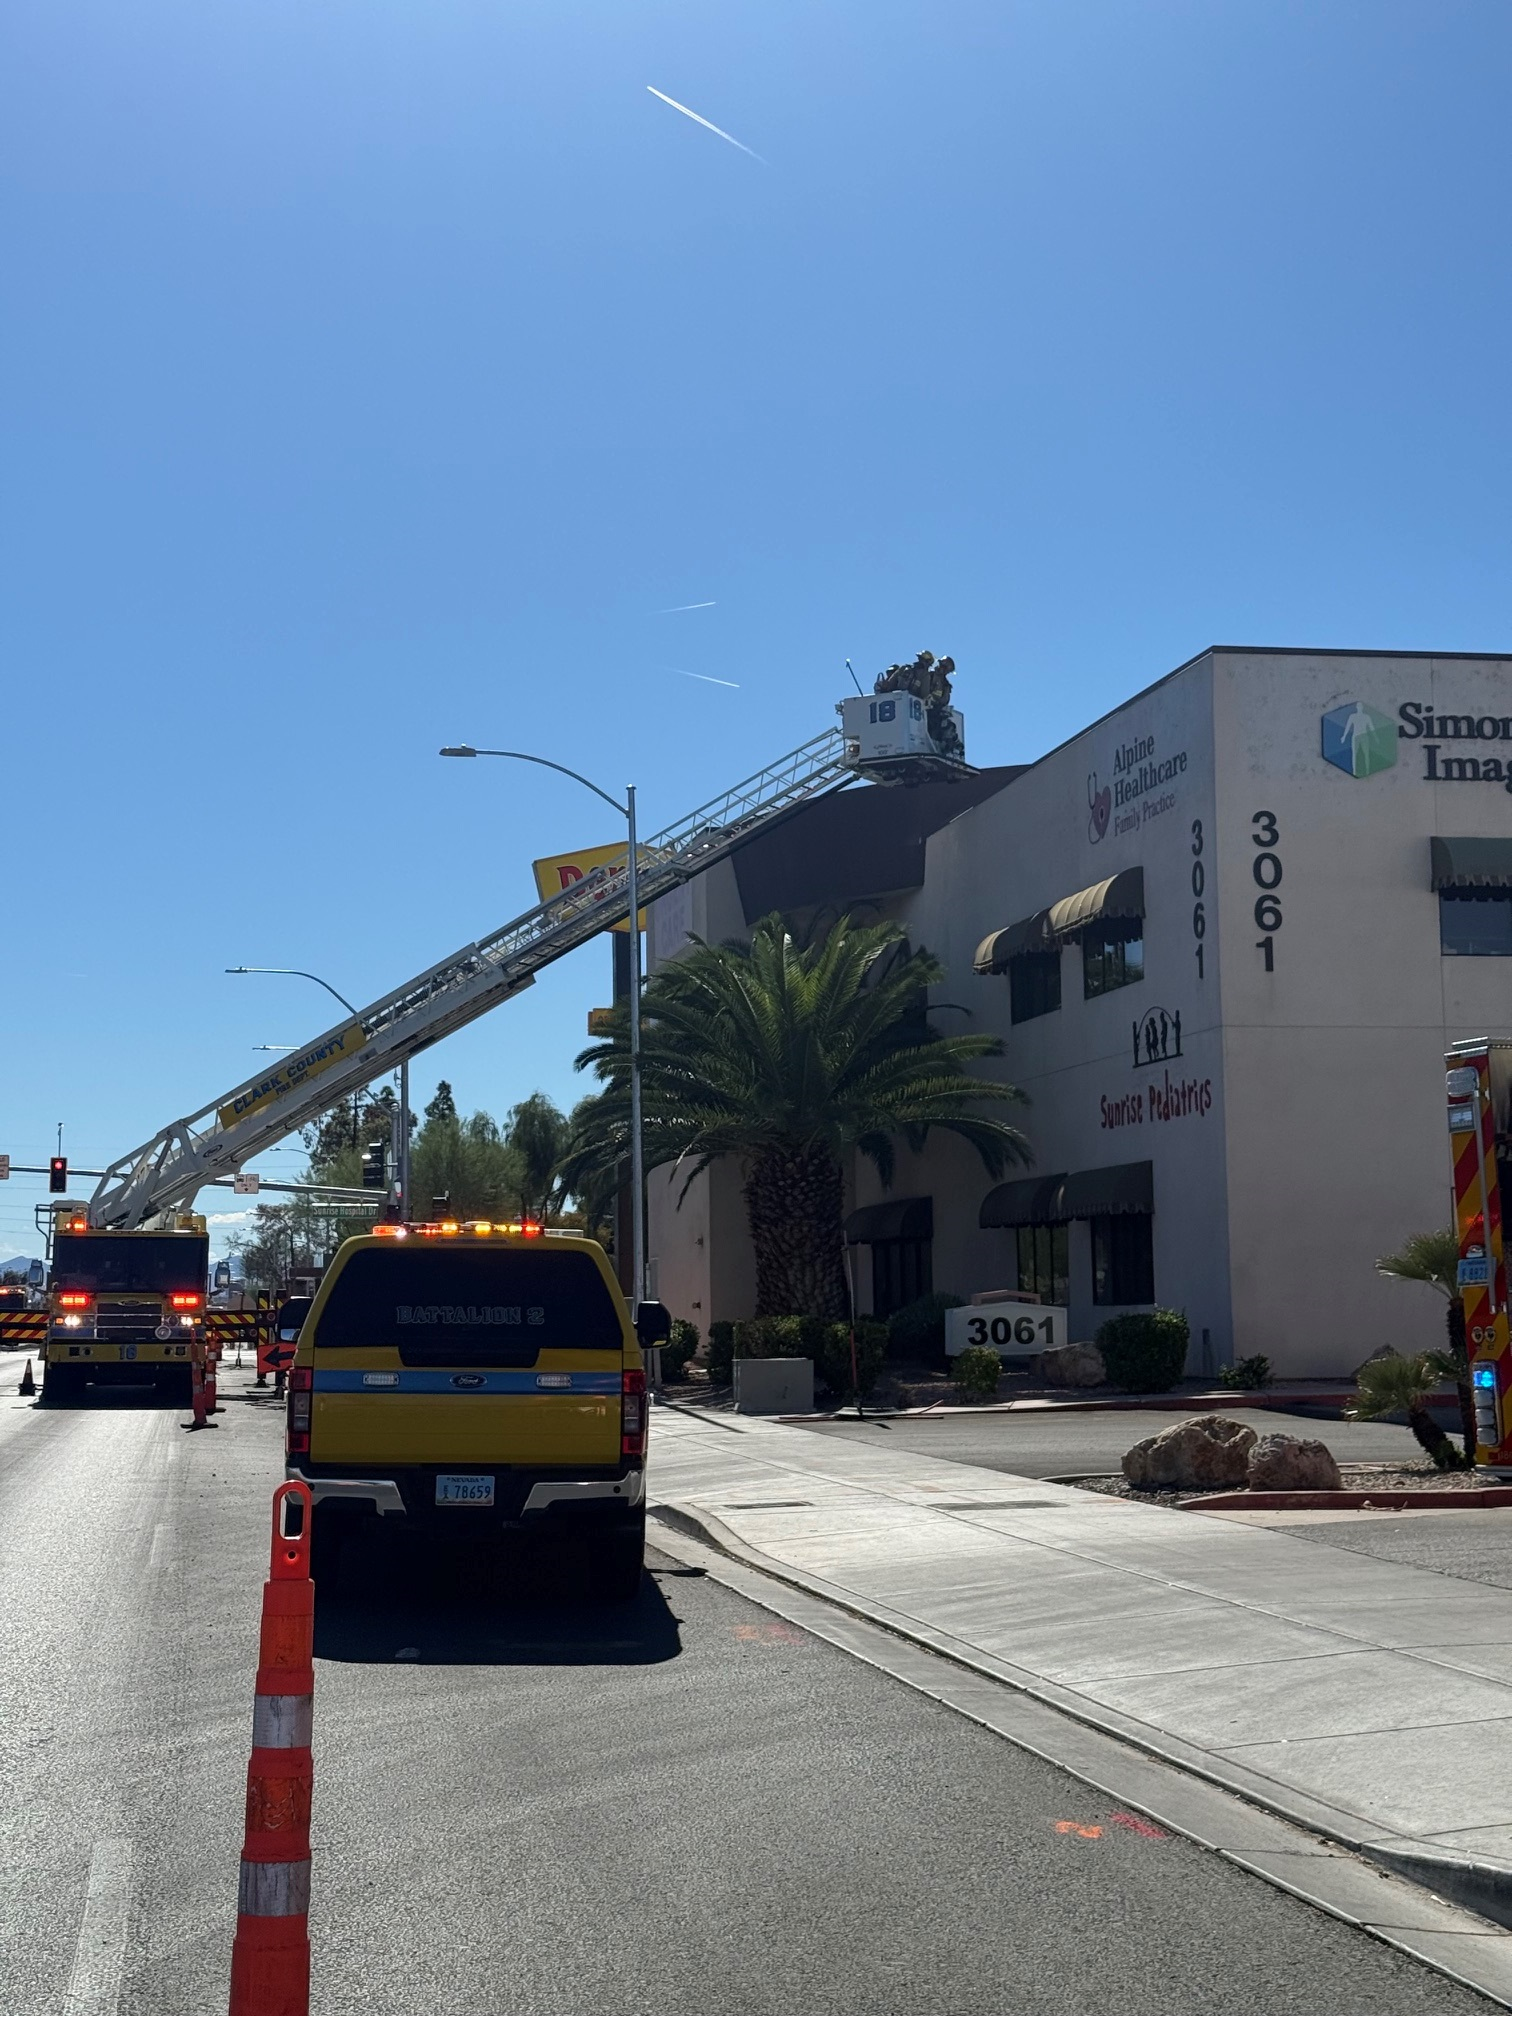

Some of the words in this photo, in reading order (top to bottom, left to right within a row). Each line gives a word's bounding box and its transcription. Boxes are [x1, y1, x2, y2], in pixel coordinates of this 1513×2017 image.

[869, 700, 896, 724] 18
[909, 697, 922, 722] 18
[1113, 735, 1155, 776] Alpine
[1113, 751, 1188, 808] Healthcare
[1114, 807, 1141, 837] Family
[1142, 792, 1176, 822] Practice
[1191, 819, 1206, 980] 3061
[1251, 810, 1283, 973] 3061
[233, 1074, 283, 1114] CLARK
[286, 1034, 346, 1078] COUNTY
[1100, 1094, 1143, 1129] Sunrise
[1149, 1068, 1212, 1122] Pediatrics
[313, 1206, 339, 1216] Sunrise
[340, 1206, 367, 1217] Hospital
[368, 1207, 377, 1216] Dr
[396, 1305, 522, 1325] BATTALION
[527, 1306, 545, 1325] 2
[967, 1315, 1054, 1346] 3061
[454, 1485, 491, 1499] 78659
